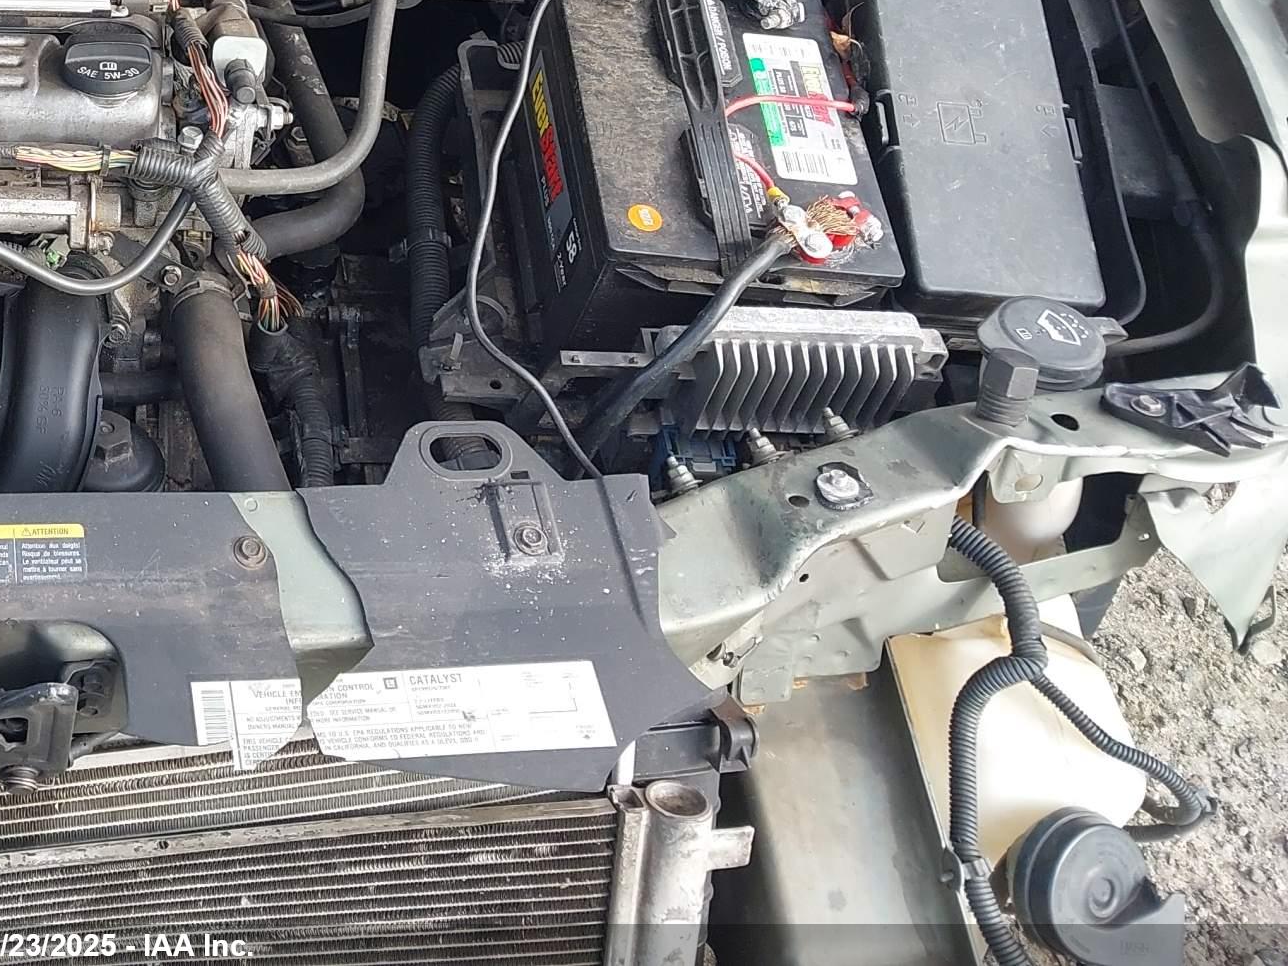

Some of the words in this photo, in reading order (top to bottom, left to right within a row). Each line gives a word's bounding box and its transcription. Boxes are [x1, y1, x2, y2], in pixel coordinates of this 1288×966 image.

[77, 66, 99, 79] SAE
[104, 67, 140, 80] 5W-30
[531, 69, 564, 203] EverStart
[540, 176, 549, 207] PLUS
[565, 230, 577, 264] 58
[32, 528, 69, 536] ATTENTION
[409, 673, 462, 685] CATALYST
[253, 689, 287, 699] VEHICLE
